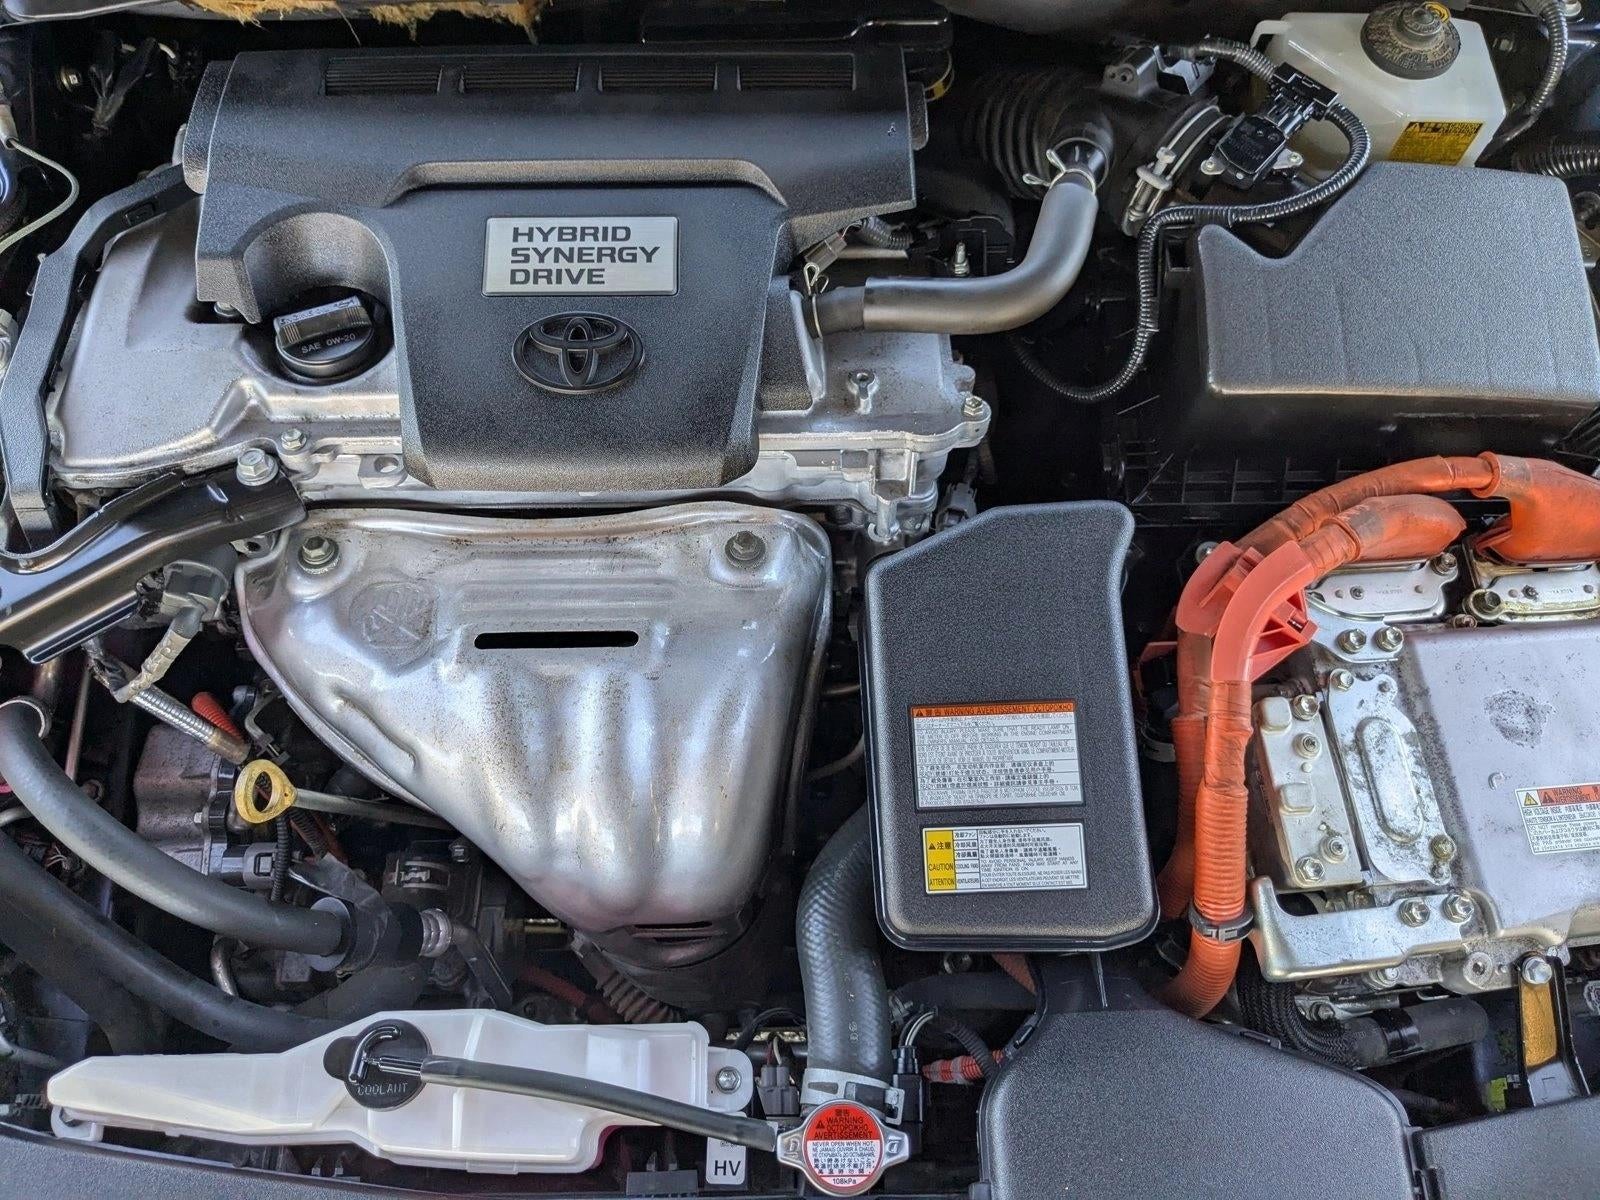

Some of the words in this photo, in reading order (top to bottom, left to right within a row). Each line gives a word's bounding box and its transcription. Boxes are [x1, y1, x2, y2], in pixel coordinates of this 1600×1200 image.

[512, 226, 631, 242] HYBRID
[511, 246, 660, 264] SYNERGY
[510, 268, 605, 285] DRIVE
[301, 341, 321, 354] SAE
[326, 332, 356, 346] 0W-20
[944, 707, 975, 716] WARNING
[977, 704, 1031, 715] AVERTISSEMENT
[928, 863, 954, 871] CAUTION
[929, 878, 955, 886] ATTENTION
[357, 1082, 408, 1096] COOLANT
[826, 1117, 864, 1125] WARNING
[814, 1131, 873, 1139] AVERTISSEMENT
[714, 1160, 741, 1176] HV
